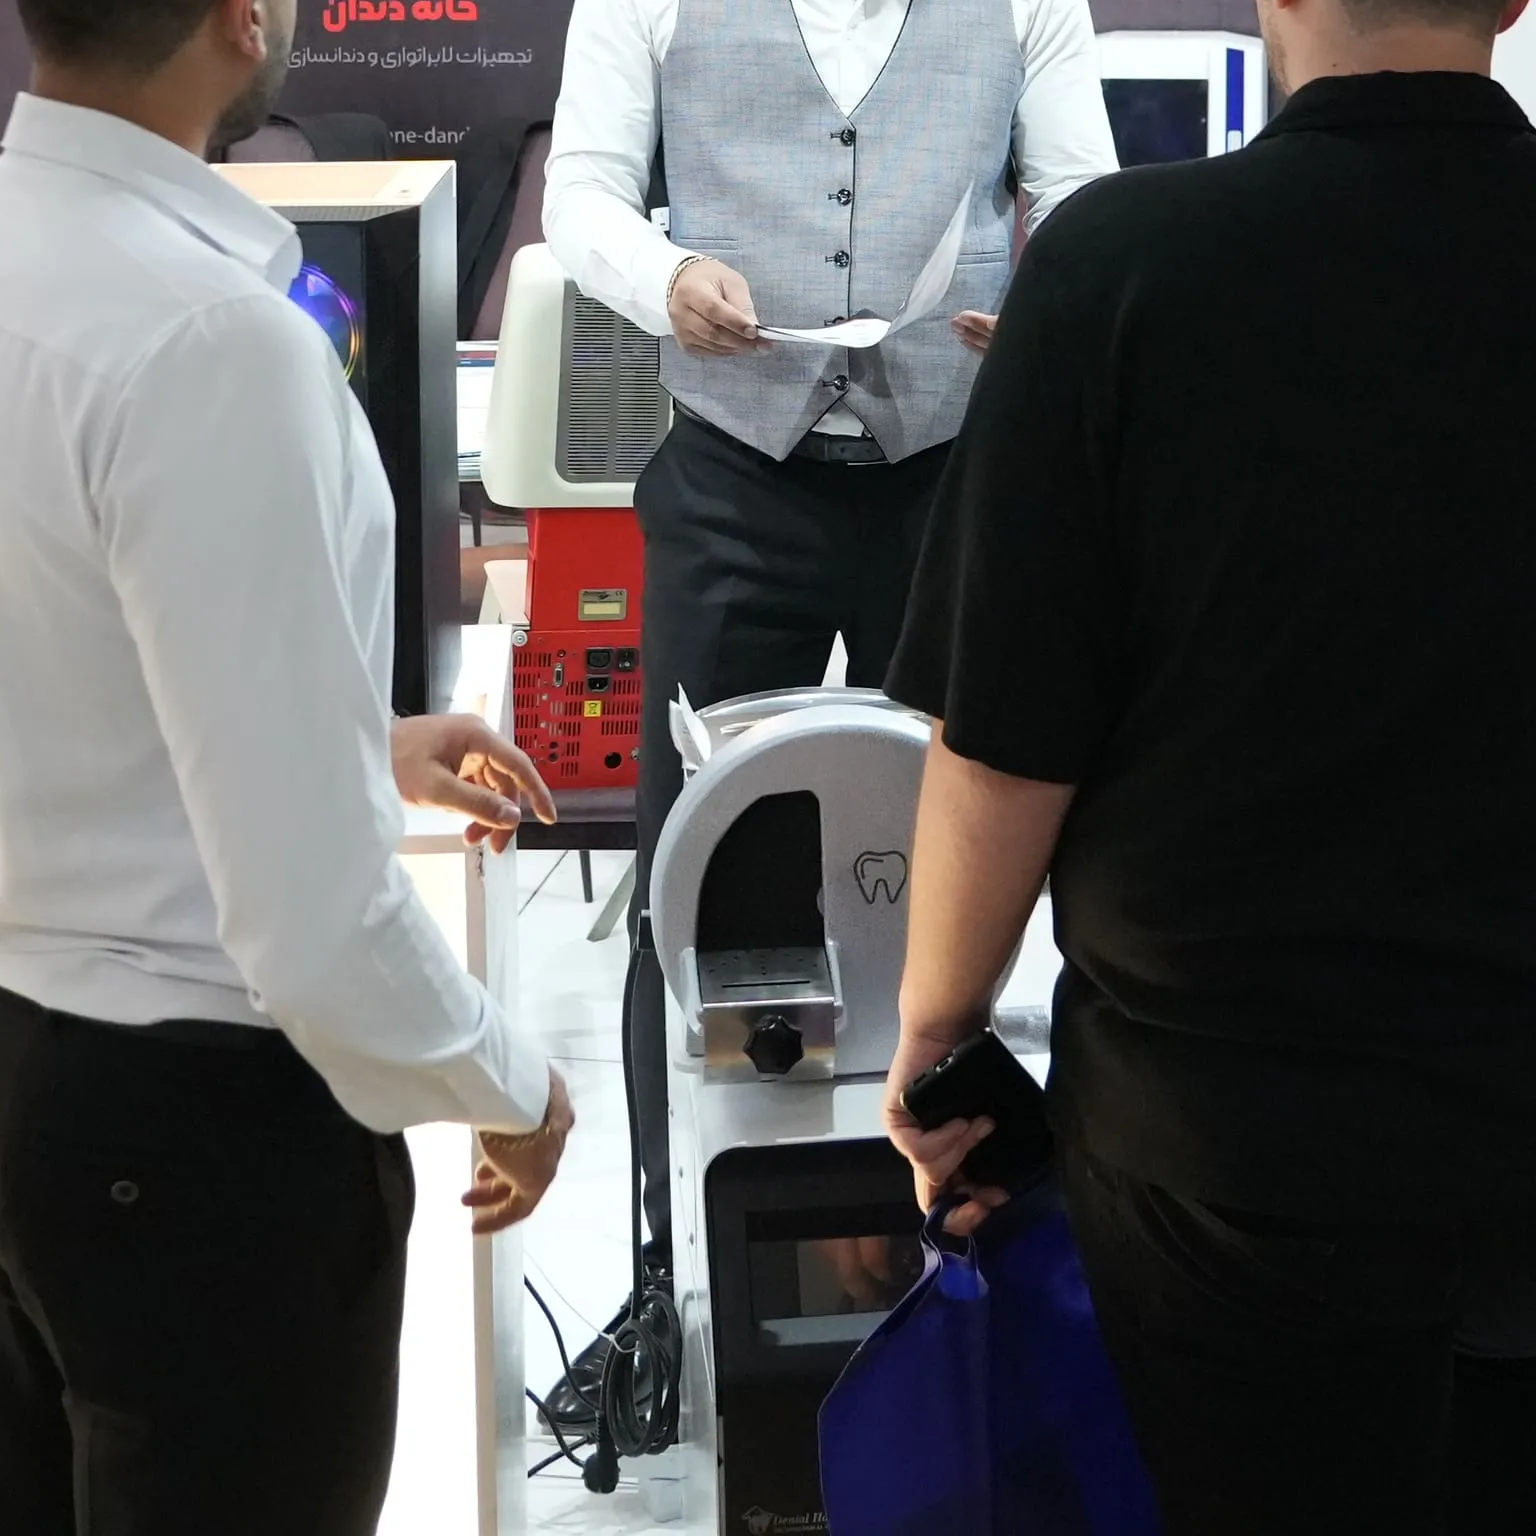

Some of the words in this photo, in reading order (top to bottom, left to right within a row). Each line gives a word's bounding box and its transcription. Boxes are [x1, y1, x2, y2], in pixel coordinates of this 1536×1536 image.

[368, 52, 378, 67] و
[380, 46, 454, 69] لابراتواری
[456, 46, 533, 68] تجهیزات
